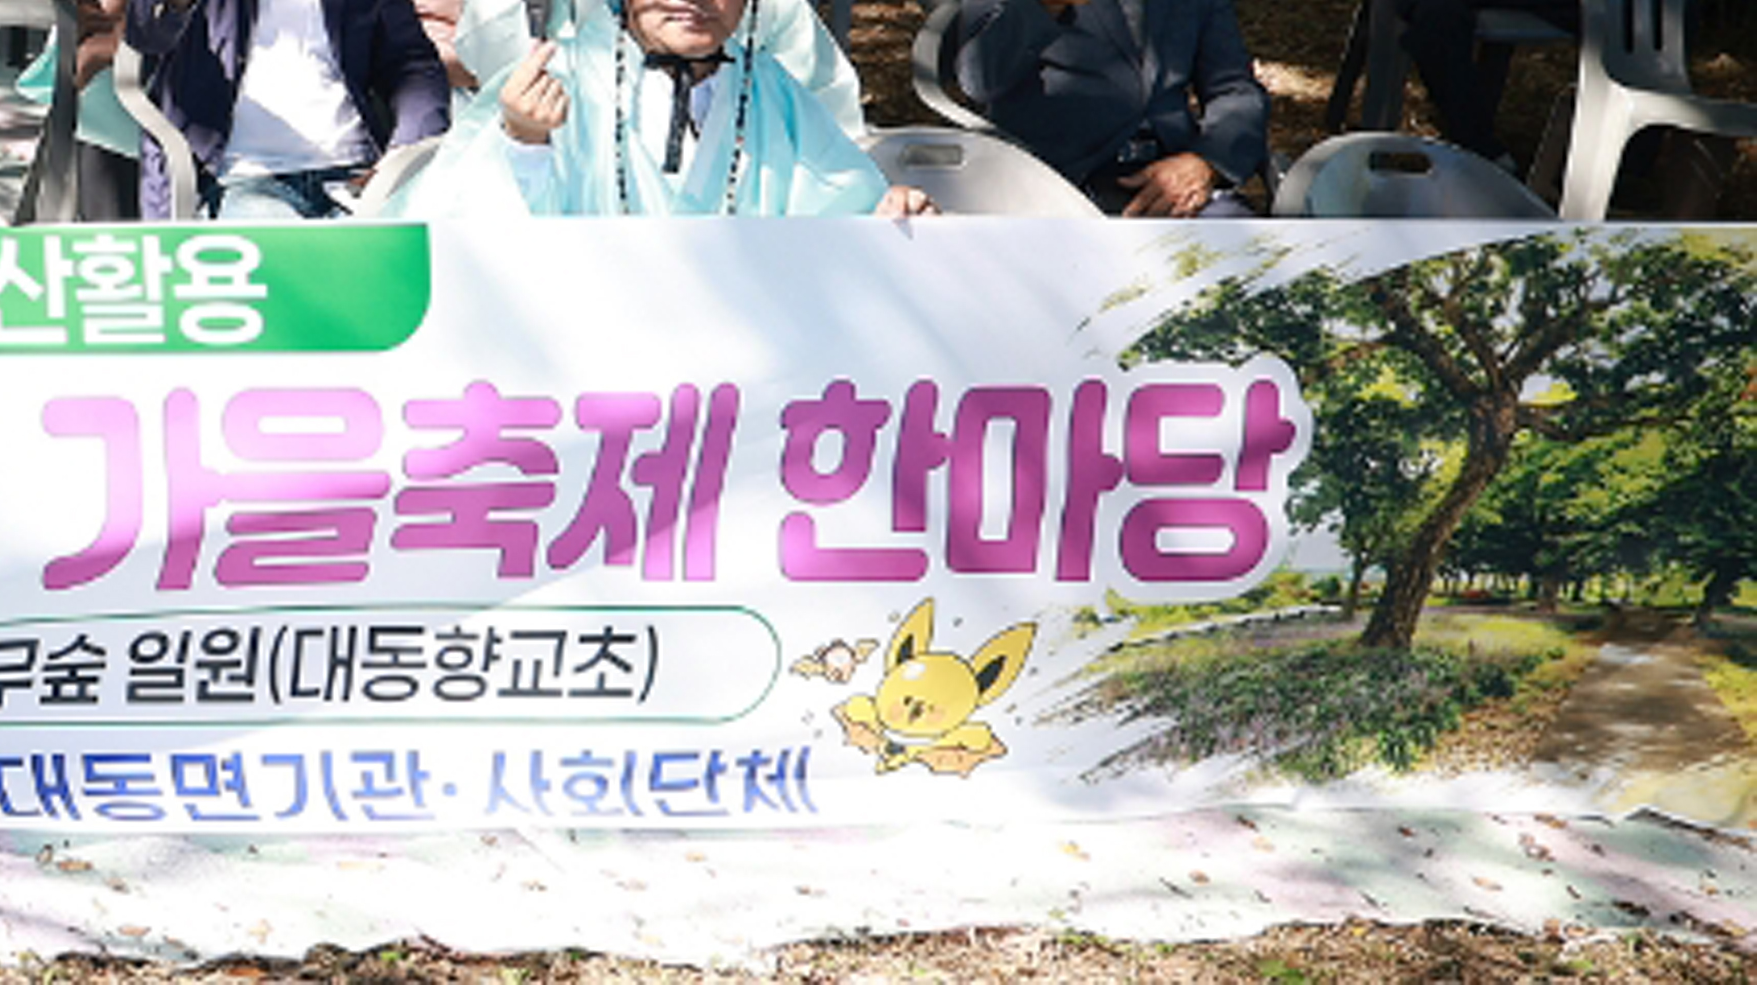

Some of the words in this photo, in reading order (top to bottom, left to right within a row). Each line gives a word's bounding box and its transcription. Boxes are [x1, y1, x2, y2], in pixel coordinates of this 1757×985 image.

[39, 377, 742, 593] 가을축제
[777, 377, 1297, 583] 한마당
[125, 624, 660, 706] 일원(대동향교초)
